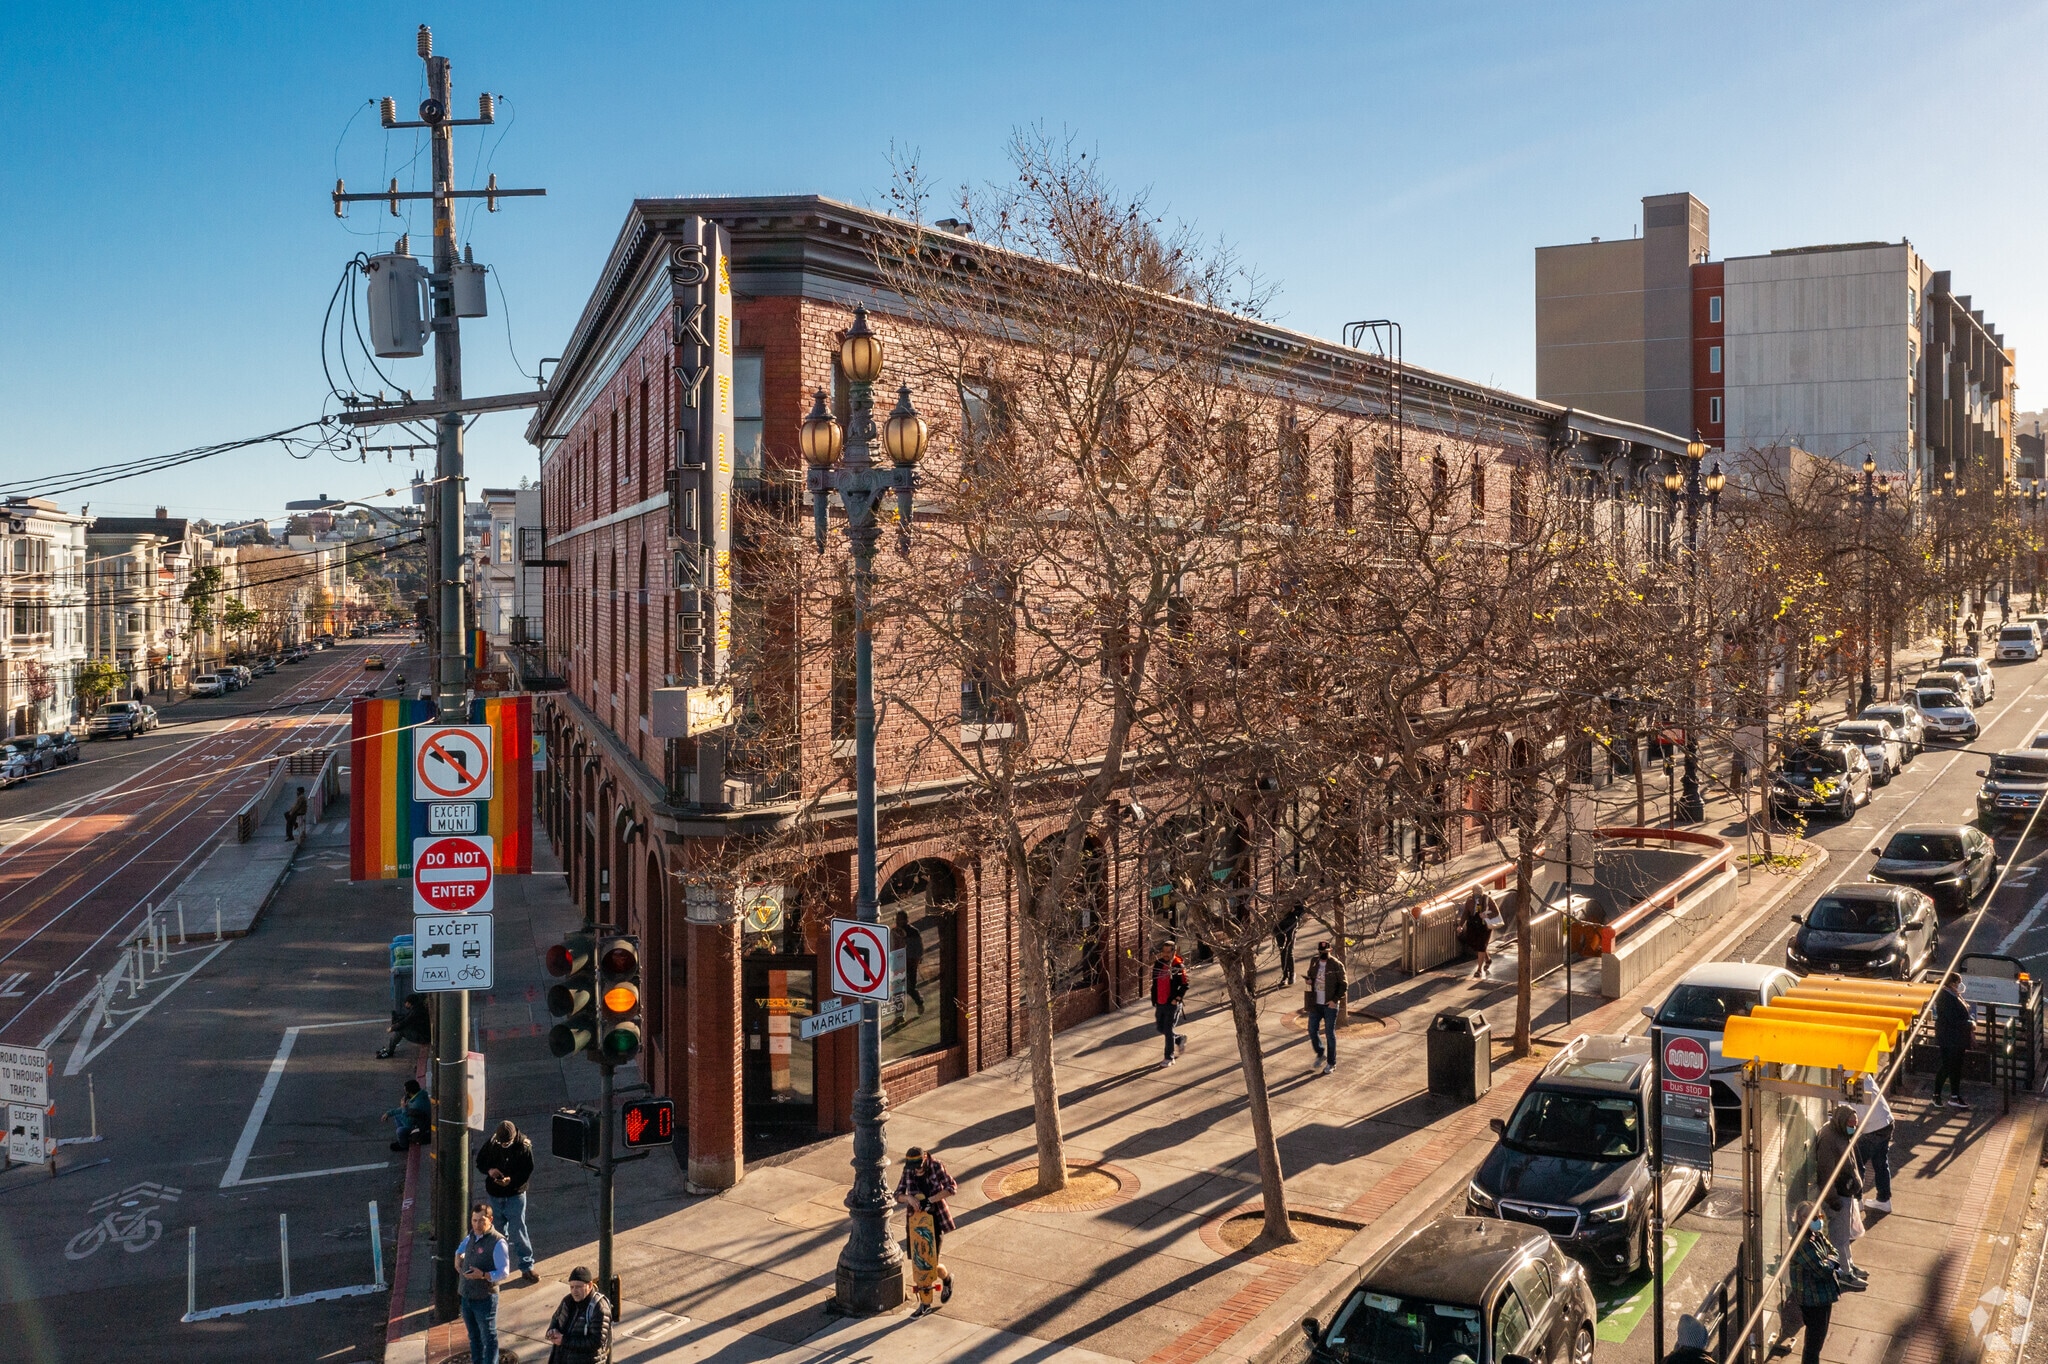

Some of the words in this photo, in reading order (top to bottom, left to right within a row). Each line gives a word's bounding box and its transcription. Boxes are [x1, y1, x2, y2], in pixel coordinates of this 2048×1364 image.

[672, 243, 710, 653] SKYLINE
[434, 806, 471, 818] EXCEPT
[438, 819, 468, 830] MUNI
[426, 853, 446, 865] DO
[454, 852, 481, 864] NOT
[431, 885, 475, 898] ENTER
[428, 923, 478, 936] EXCEPT
[425, 971, 447, 979] TAXI
[754, 998, 806, 1008] VERVE
[881, 1002, 904, 1016] BLEND
[811, 1009, 854, 1033] MARKET
[0, 1052, 18, 1064] ROAD
[20, 1054, 45, 1068] CLOSED
[2, 1067, 11, 1079] TO
[13, 1069, 44, 1083] THROUGH
[10, 1083, 37, 1098] TRAFFIC
[1670, 1082, 1684, 1092] bus
[1685, 1086, 1702, 1096] stop
[1665, 1094, 1673, 1105] F
[14, 1110, 38, 1122] EXCEPT
[659, 1107, 671, 1136] 0
